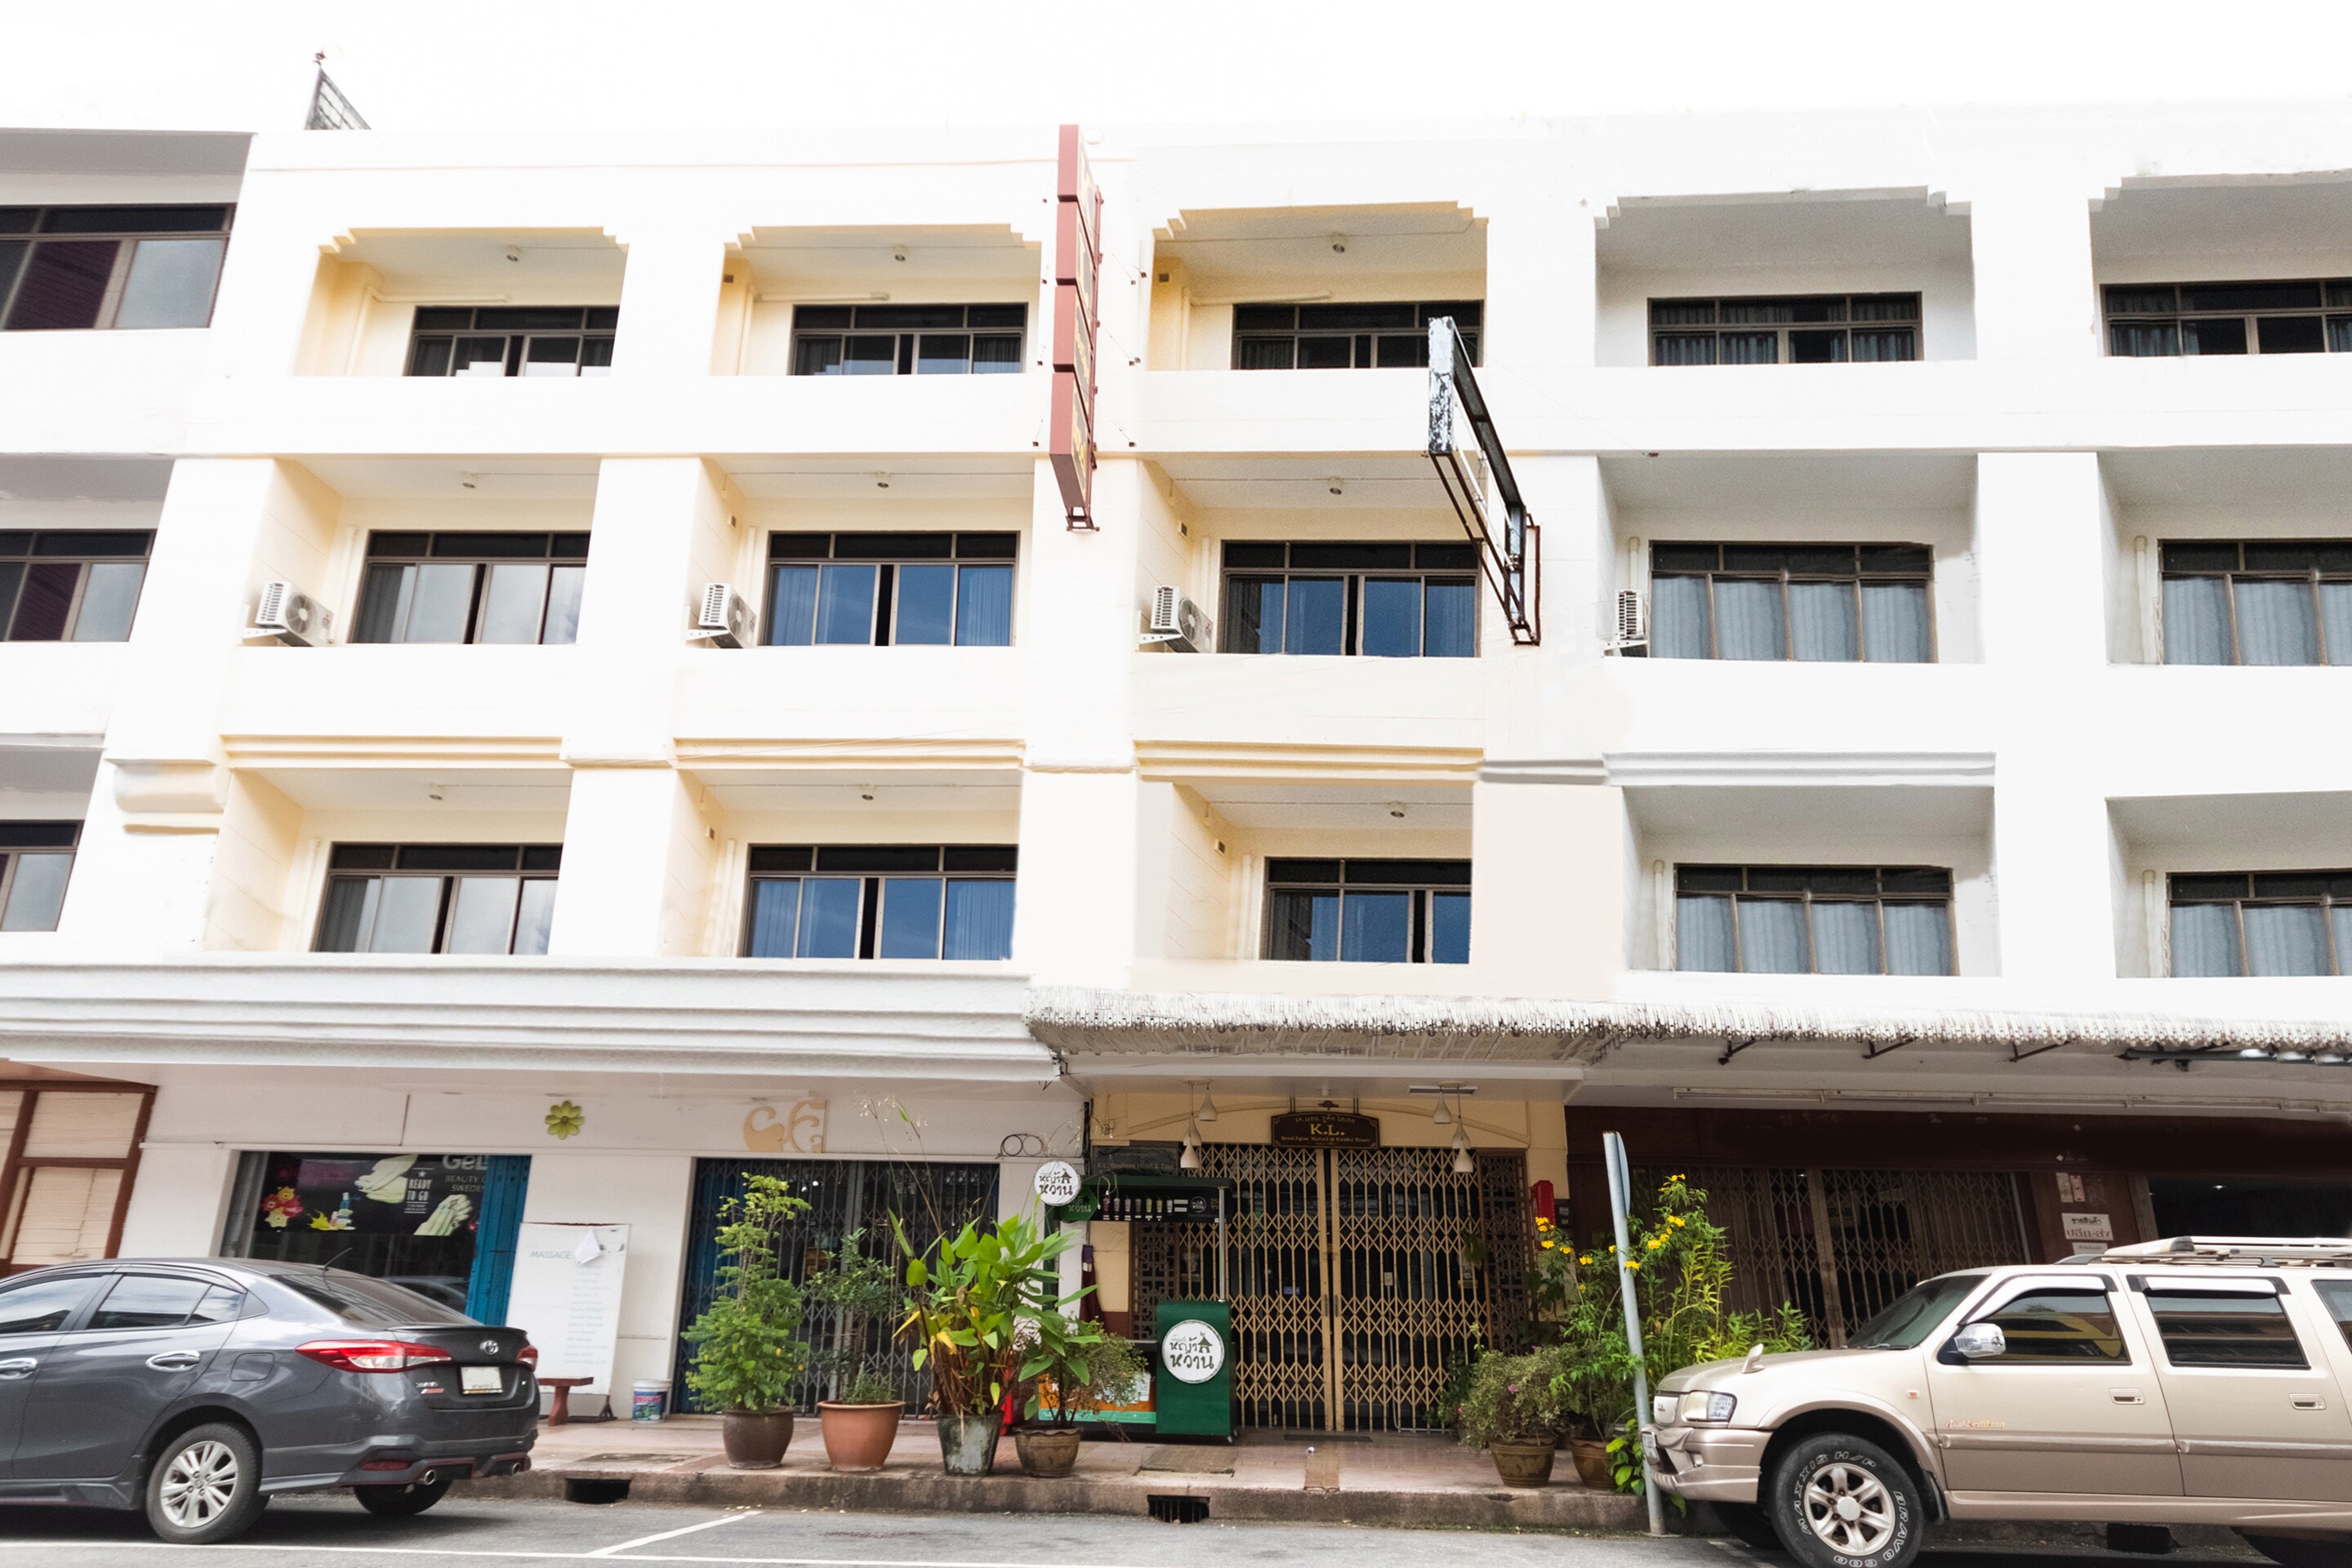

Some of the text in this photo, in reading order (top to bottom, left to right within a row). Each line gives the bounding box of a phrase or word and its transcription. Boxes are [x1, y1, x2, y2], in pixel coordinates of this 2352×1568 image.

[1310, 1123, 1346, 1136] K.L.
[408, 1178, 432, 1189] READY
[444, 1174, 478, 1183] BEAUTY
[407, 1190, 429, 1201] TO GO
[1039, 1184, 1073, 1196] หวาน
[1169, 1336, 1197, 1354] หญ้า
[1169, 1353, 1214, 1370] หวาน
[1793, 1454, 1829, 1535] MAXXIS
[1882, 1490, 1909, 1561] BRAVO
